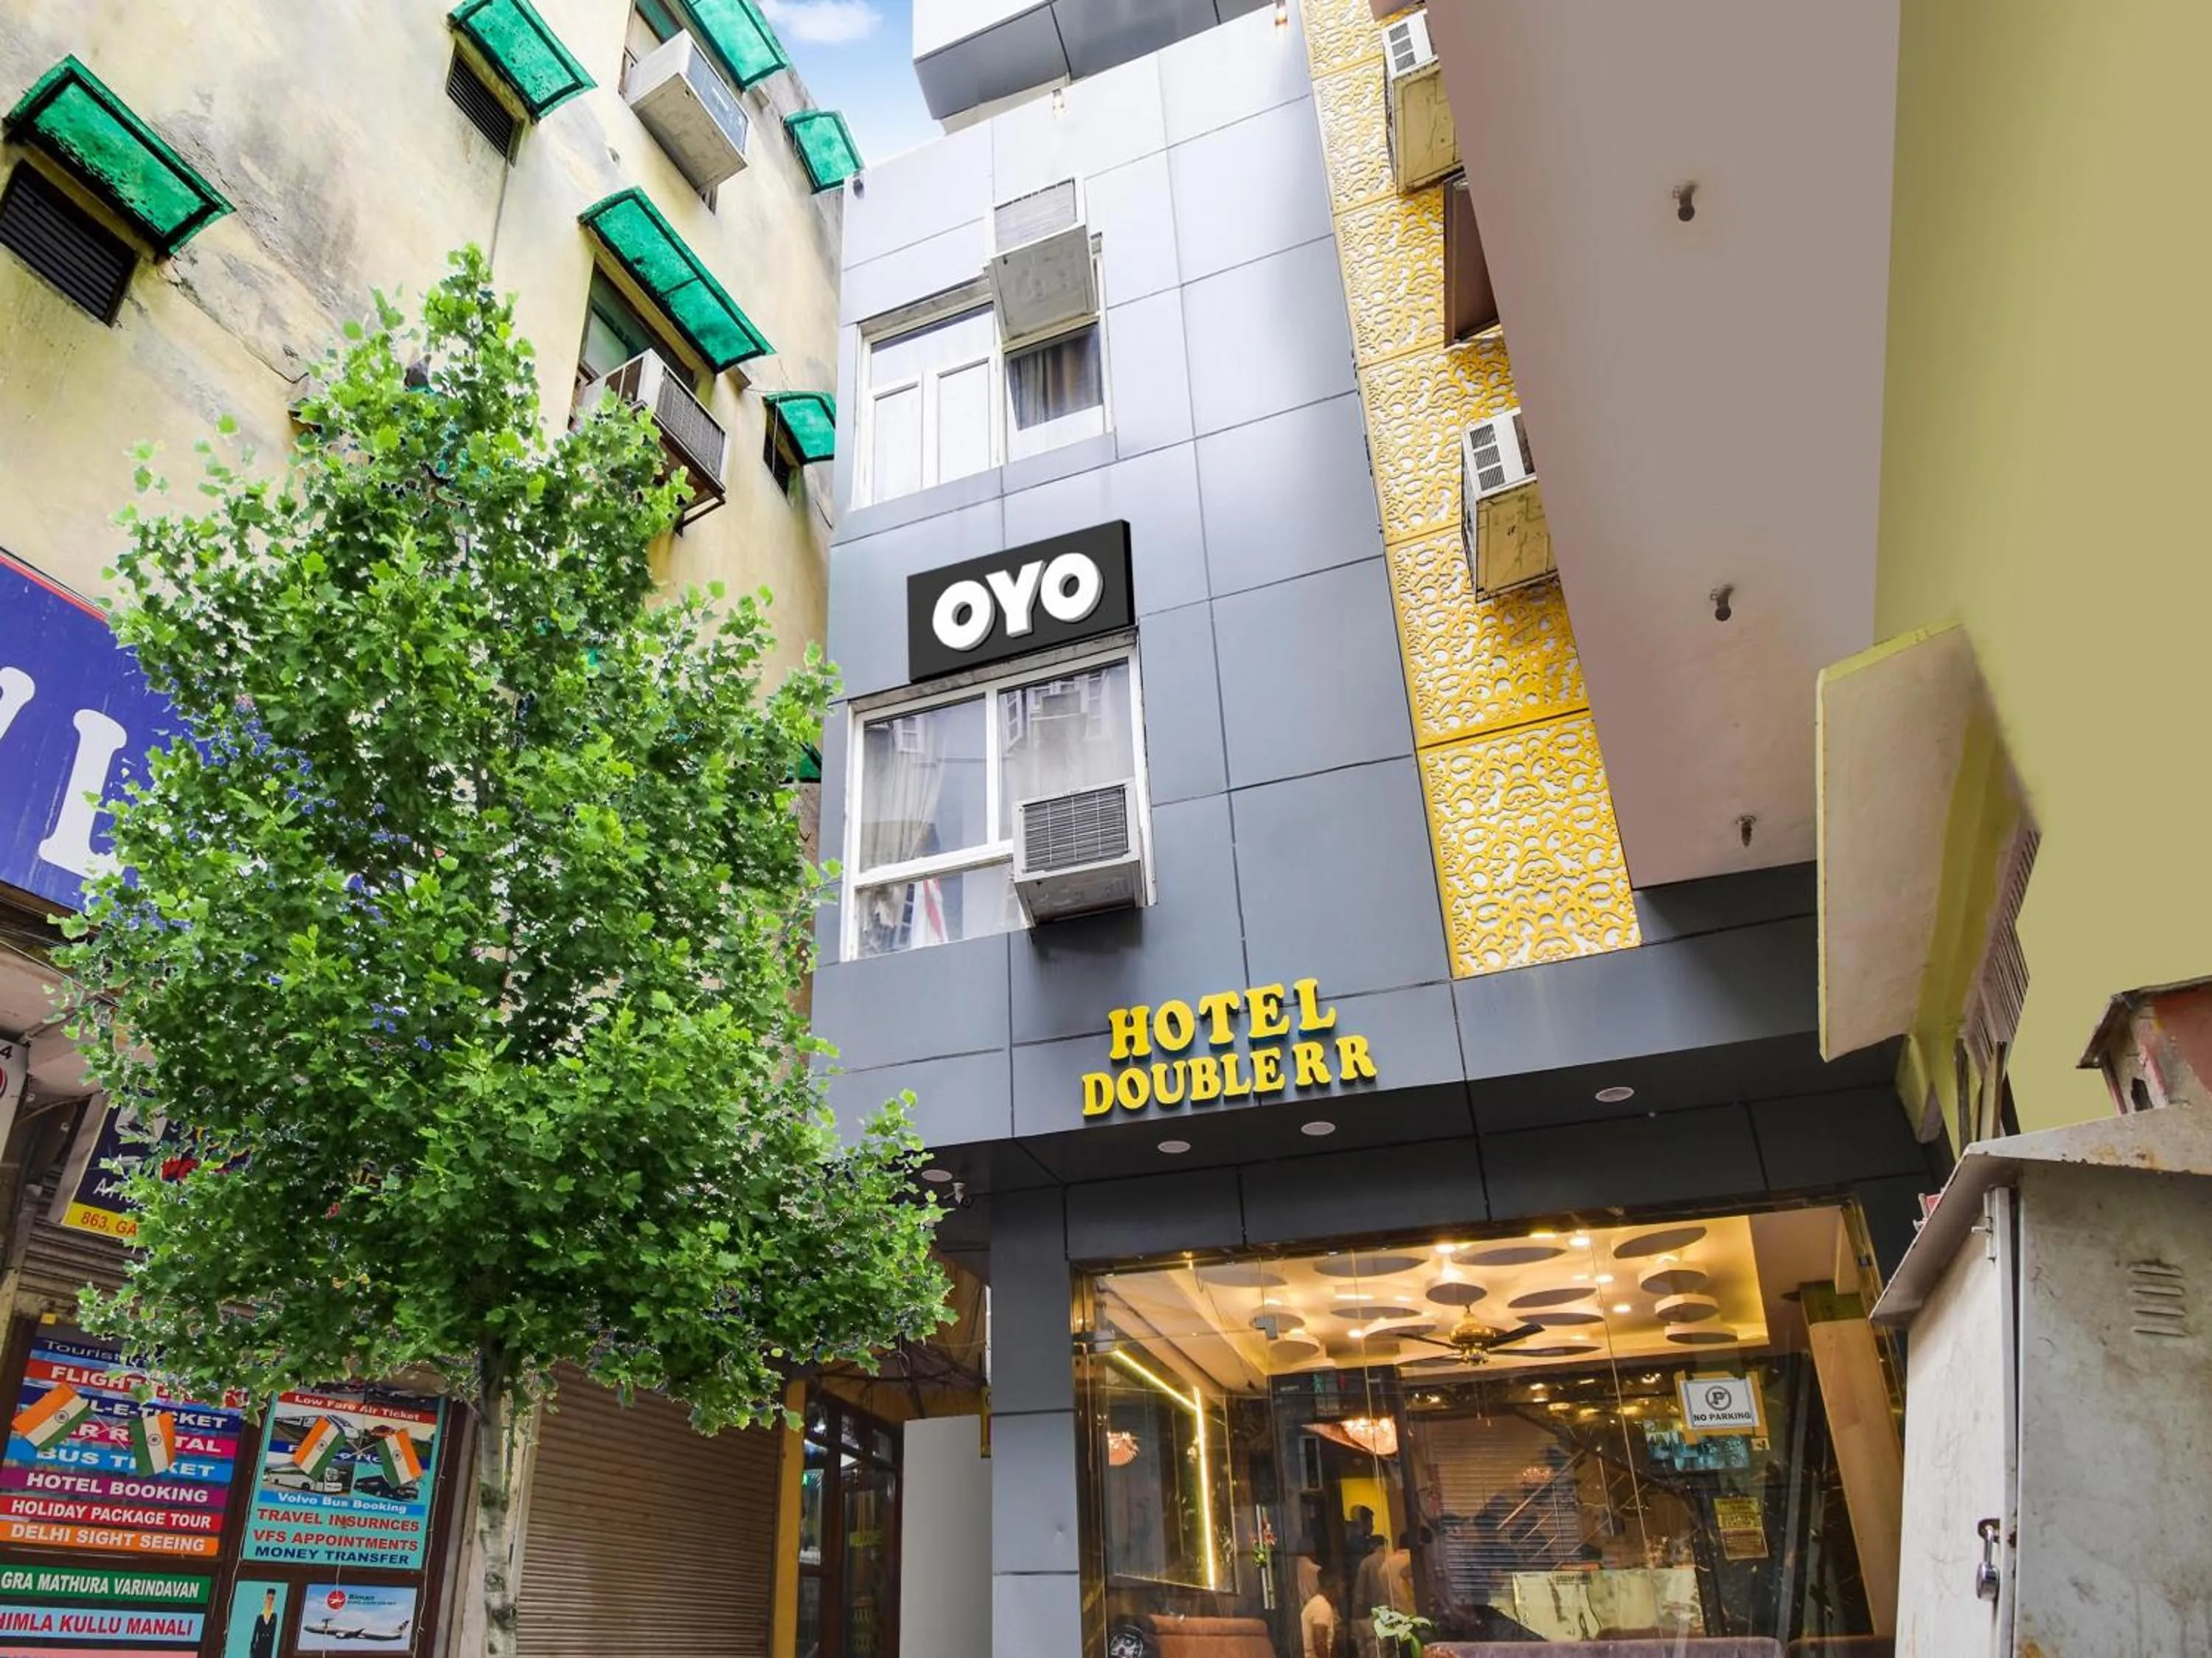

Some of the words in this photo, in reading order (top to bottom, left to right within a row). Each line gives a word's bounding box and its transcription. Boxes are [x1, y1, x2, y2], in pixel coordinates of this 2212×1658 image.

[932, 552, 1103, 652] OYO
[1107, 977, 1337, 1061] HOTEL
[1082, 1046, 1286, 1117] DOUBLE
[50, 1365, 142, 1390] FLIGHT
[295, 1395, 323, 1406] Low
[327, 1398, 356, 1411] Fare
[359, 1404, 378, 1416] Air
[381, 1407, 421, 1421] Ticket
[1709, 1411, 1750, 1421] PARKING
[110, 1454, 215, 1477] TIKET
[27, 1472, 102, 1494] HOTEL
[110, 1482, 209, 1503] BOOKING
[11, 1499, 87, 1519] HOLIDAY
[91, 1506, 166, 1526] PACKAGE
[170, 1513, 211, 1529] TOUR
[278, 1492, 319, 1506] Volvo
[322, 1496, 349, 1508] Bus
[352, 1499, 407, 1515] Booking
[257, 1508, 322, 1525] TRAVEL
[329, 1513, 420, 1533] INSURNCES
[11, 1524, 71, 1541] DELHI
[76, 1528, 136, 1547] SIGHT
[139, 1535, 206, 1552] SEEING
[253, 1529, 287, 1543] VFS
[292, 1531, 419, 1552] APPOINTMENTS
[254, 1545, 319, 1560] MONEY
[324, 1549, 409, 1565] TRANSFER
[37, 1572, 109, 1595] MATHURA
[114, 1578, 200, 1598] VARINDAVAN
[59, 1614, 122, 1634] KULLU
[126, 1617, 194, 1637] MANALI
